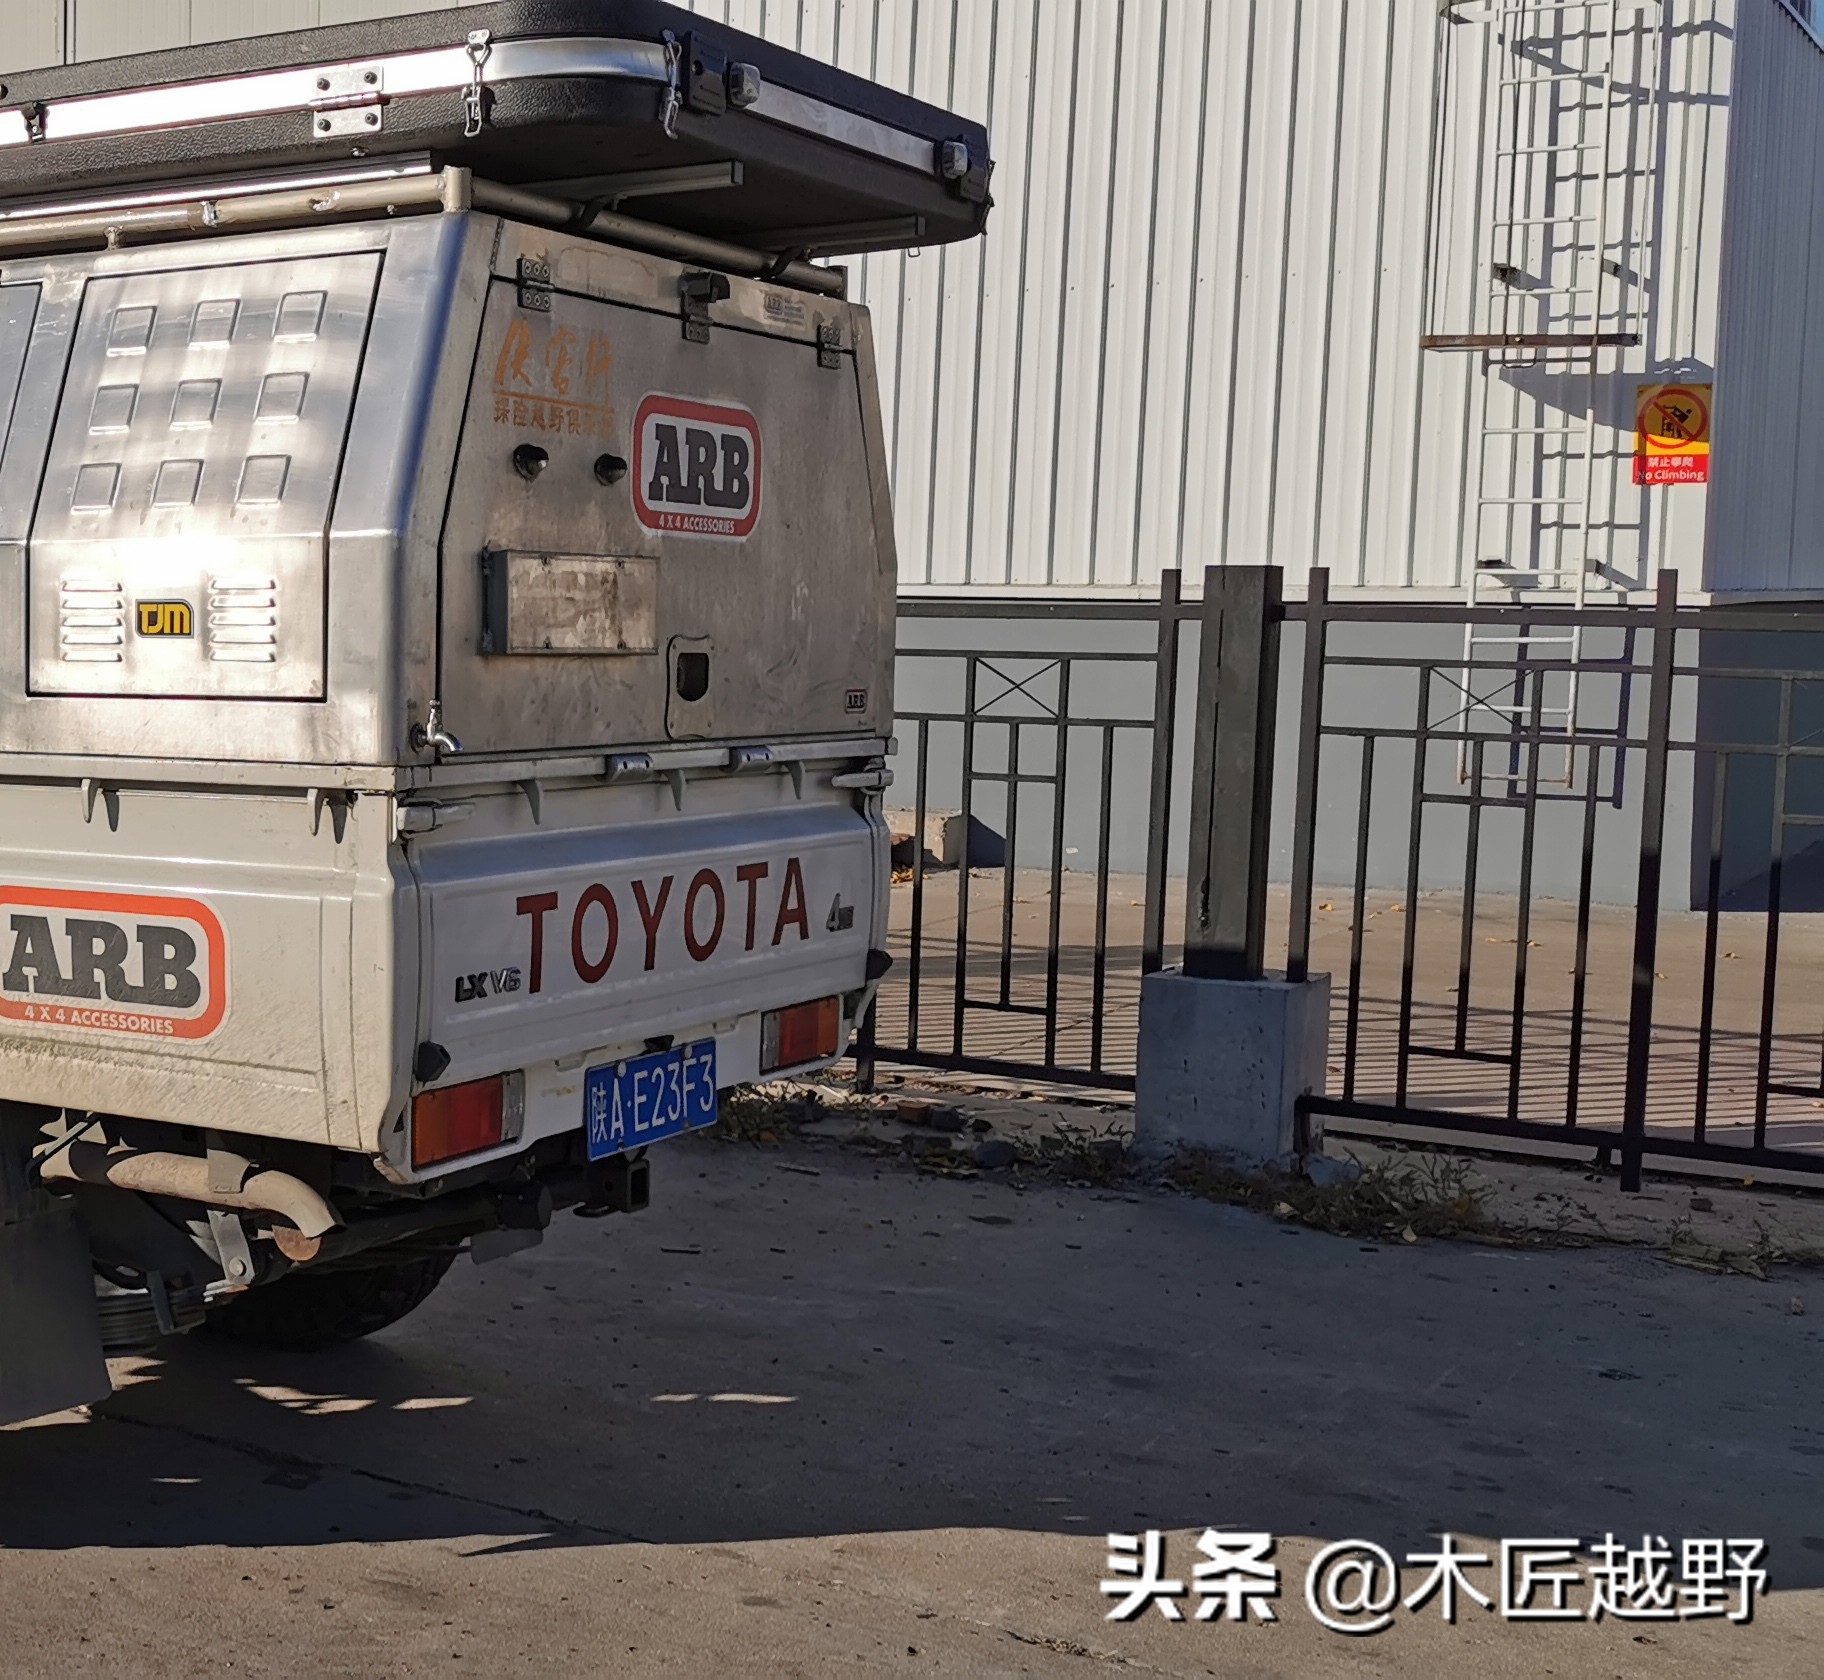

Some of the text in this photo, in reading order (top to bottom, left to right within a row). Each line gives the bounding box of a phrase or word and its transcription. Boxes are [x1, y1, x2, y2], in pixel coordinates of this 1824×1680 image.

[648, 422, 750, 510] ARB
[1638, 469, 1705, 481] No Climbing
[658, 513, 665, 528] 4
[676, 516, 682, 530] 4
[682, 517, 735, 534] ACCESSORIES
[139, 603, 190, 634] TJM
[516, 857, 810, 995] TOYOTA
[2, 913, 202, 1009] ARB
[455, 966, 521, 1003] LX V6
[24, 1004, 34, 1019] 4
[55, 1008, 66, 1023] 4
[70, 1009, 174, 1035] ACCESSORIES
